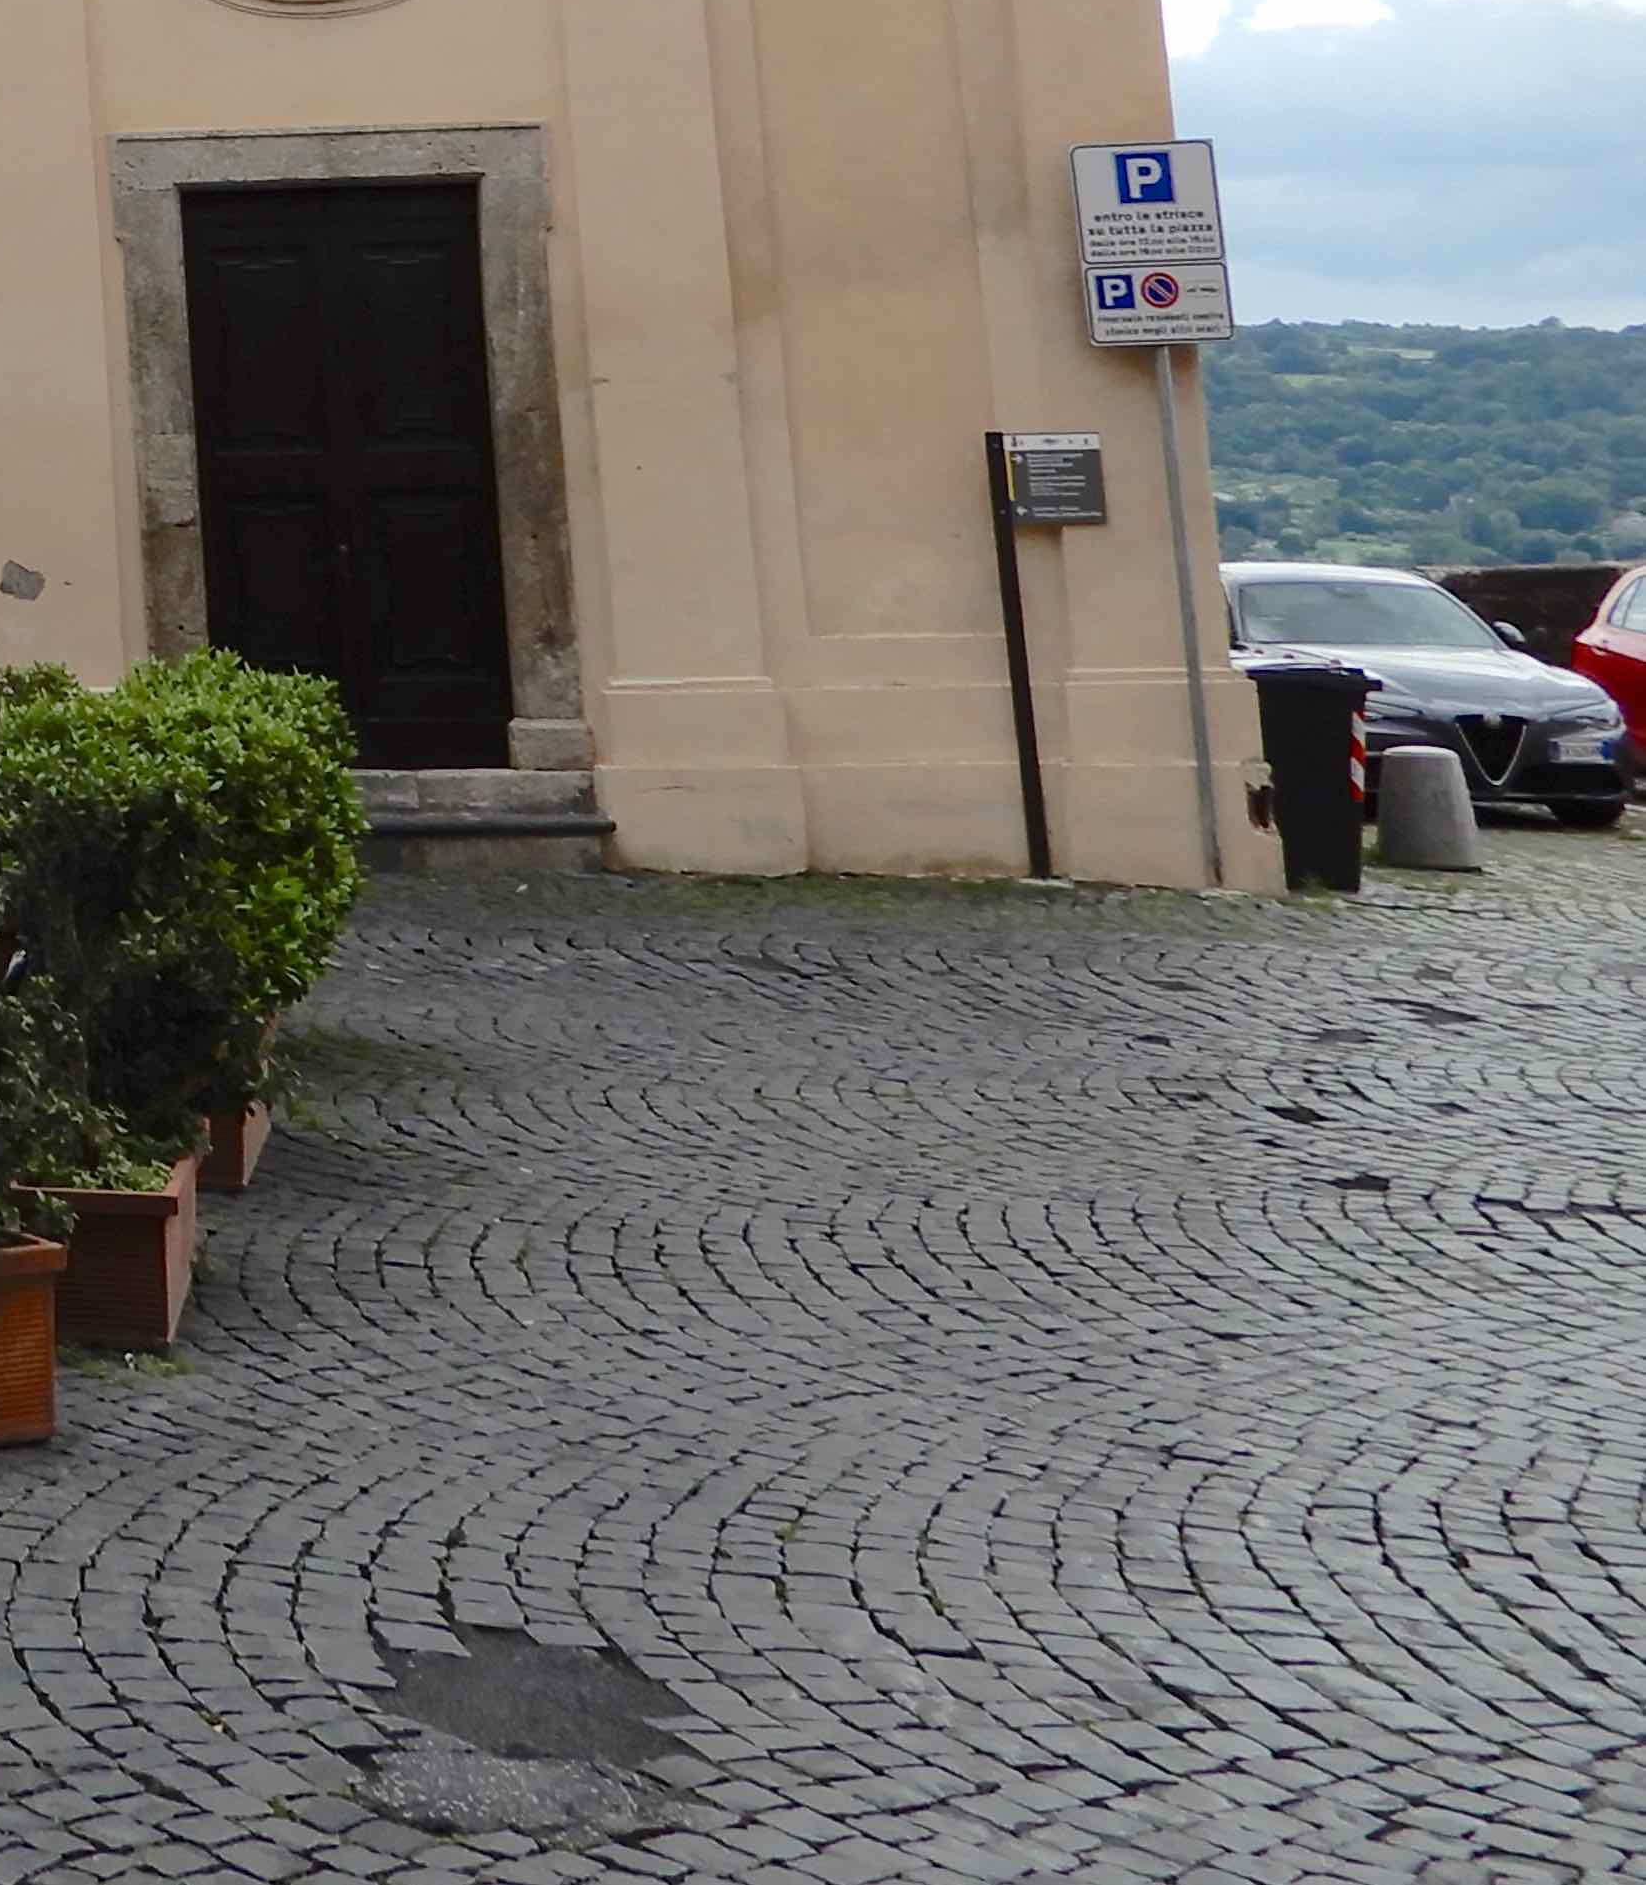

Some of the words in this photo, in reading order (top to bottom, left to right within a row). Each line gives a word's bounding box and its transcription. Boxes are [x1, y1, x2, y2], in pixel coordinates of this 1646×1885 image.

[1125, 157, 1163, 199] P
[1094, 211, 1133, 222] entro
[1136, 209, 1150, 221] le
[1154, 207, 1204, 221] strisce
[1088, 226, 1105, 236] su
[1108, 223, 1147, 235] tutta
[1150, 222, 1165, 234] la
[1168, 221, 1213, 234] piazza
[1102, 277, 1128, 307] P
